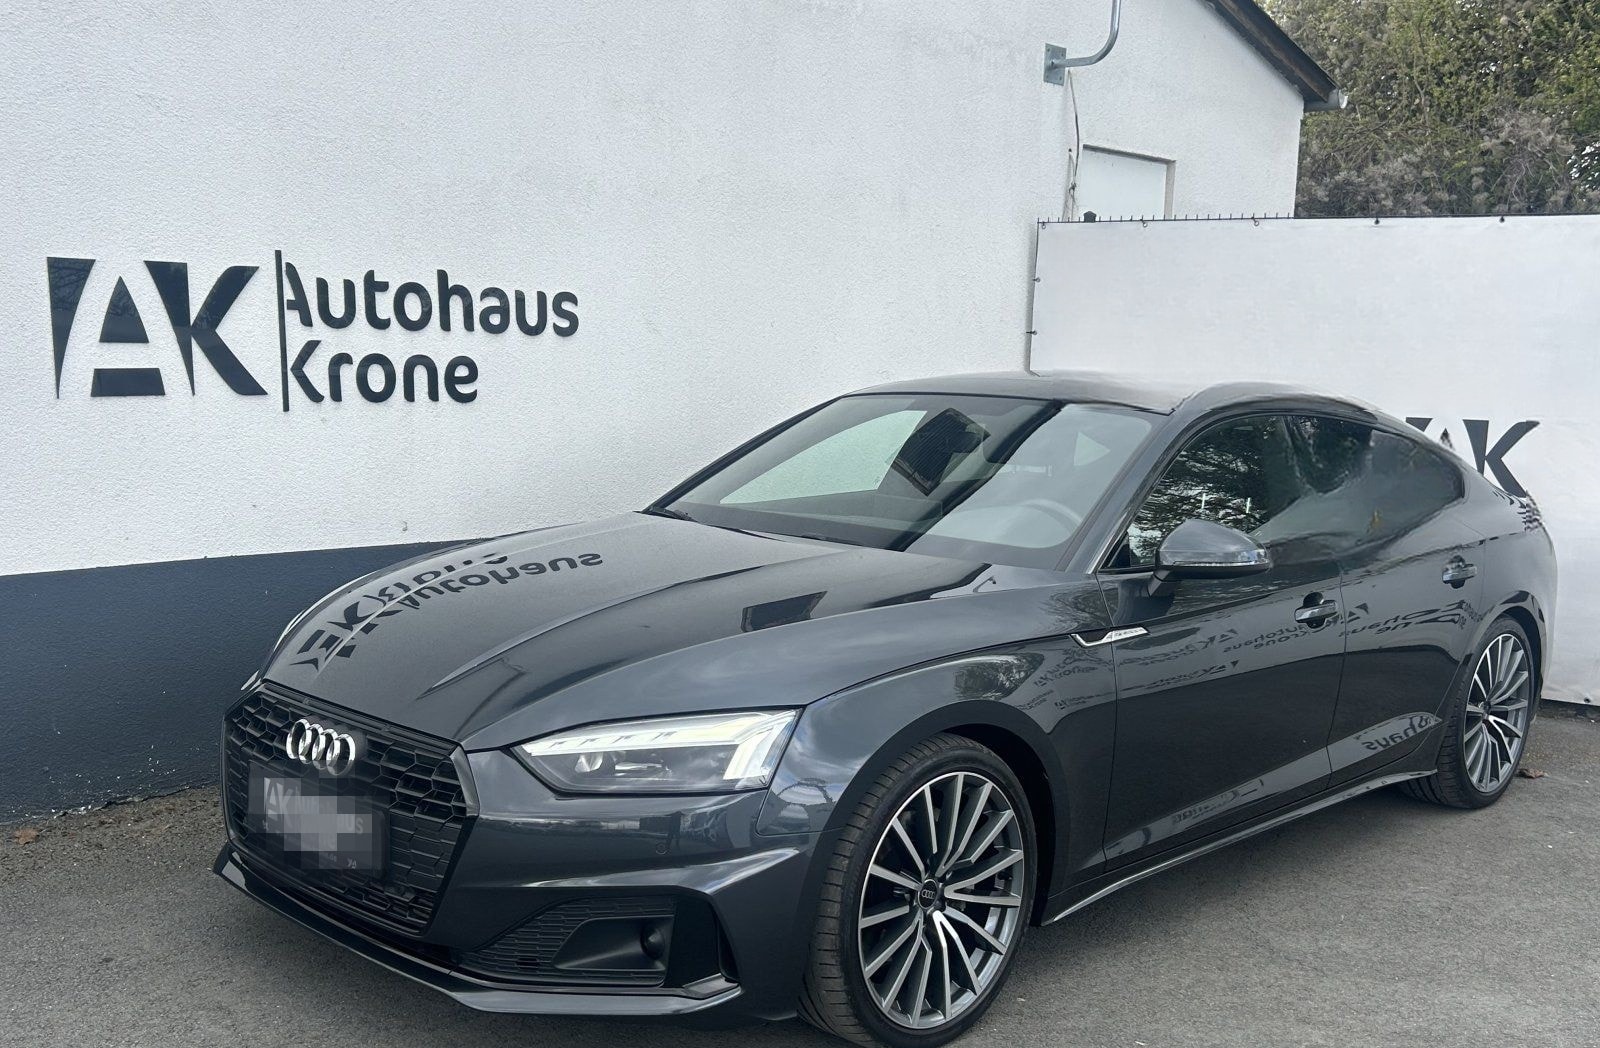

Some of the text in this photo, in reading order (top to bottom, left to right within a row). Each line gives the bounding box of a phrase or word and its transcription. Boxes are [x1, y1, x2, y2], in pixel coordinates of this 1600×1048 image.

[47, 256, 268, 399] AK
[285, 261, 579, 337] Autohaus
[289, 339, 479, 403] Krone
